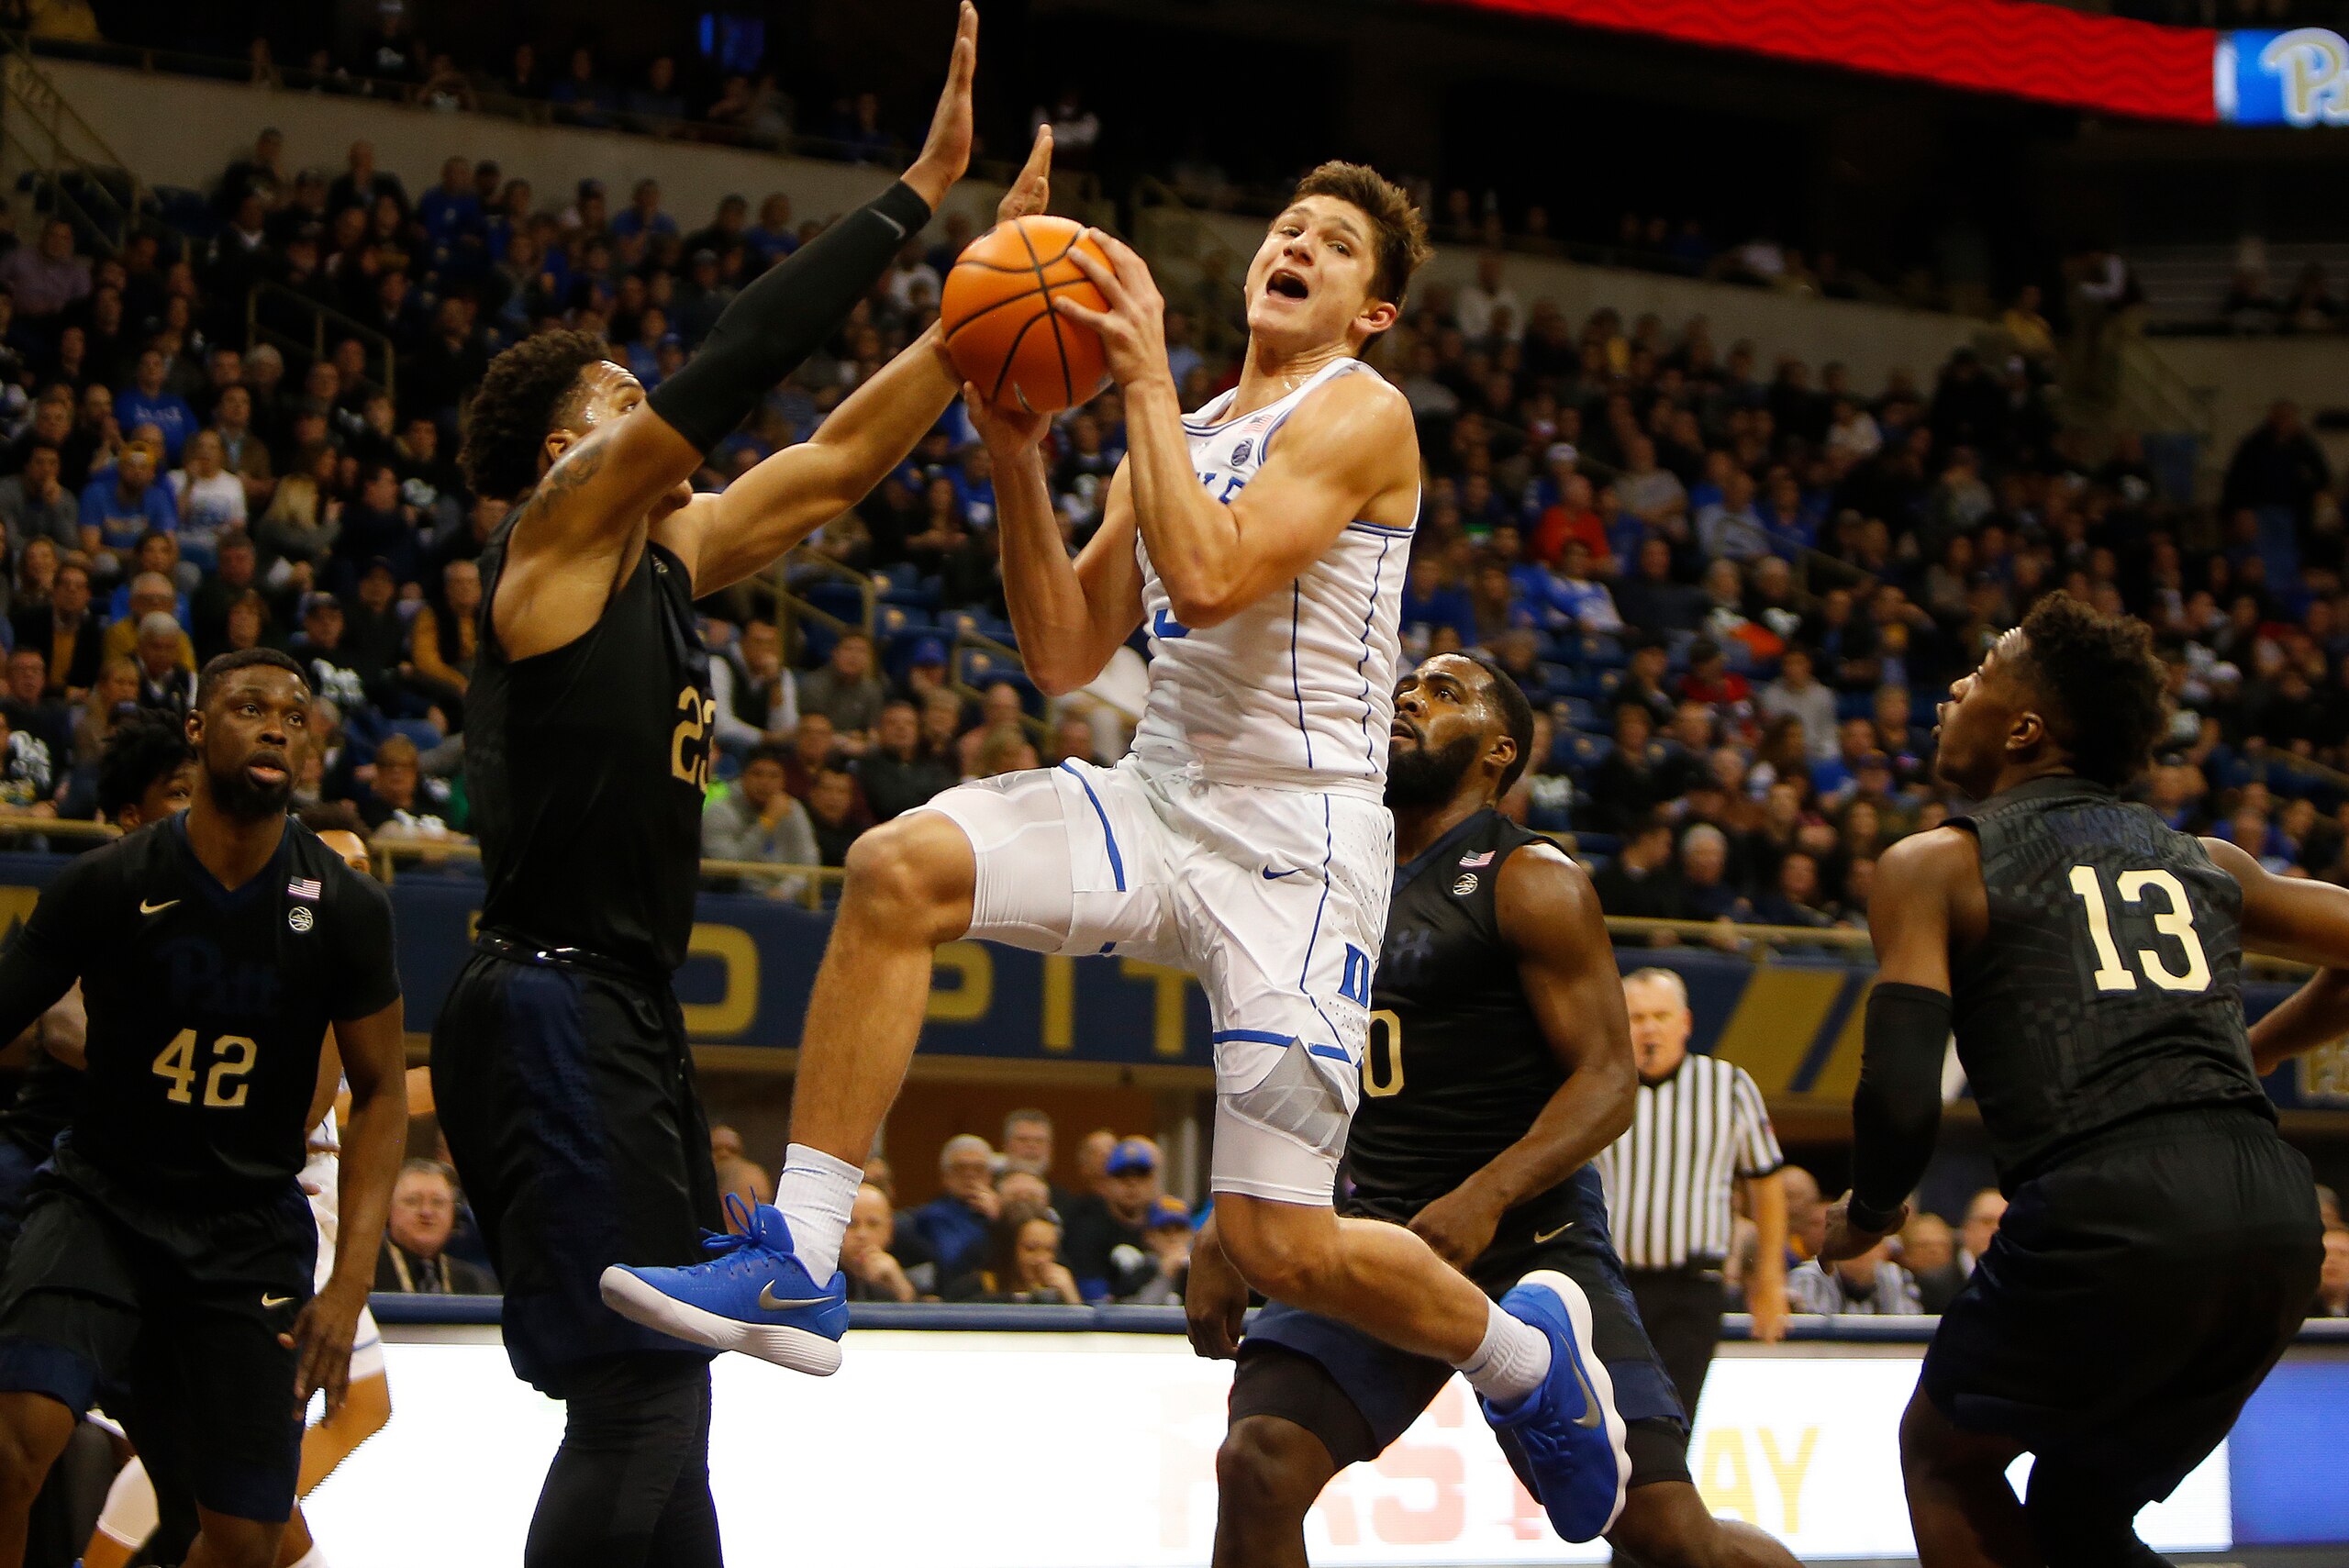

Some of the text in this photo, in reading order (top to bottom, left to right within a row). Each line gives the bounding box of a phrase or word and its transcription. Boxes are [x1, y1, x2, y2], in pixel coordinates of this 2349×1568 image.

[2068, 864, 2213, 992] 13
[151, 1028, 258, 1108] 42
[1362, 1009, 1405, 1097] 0
